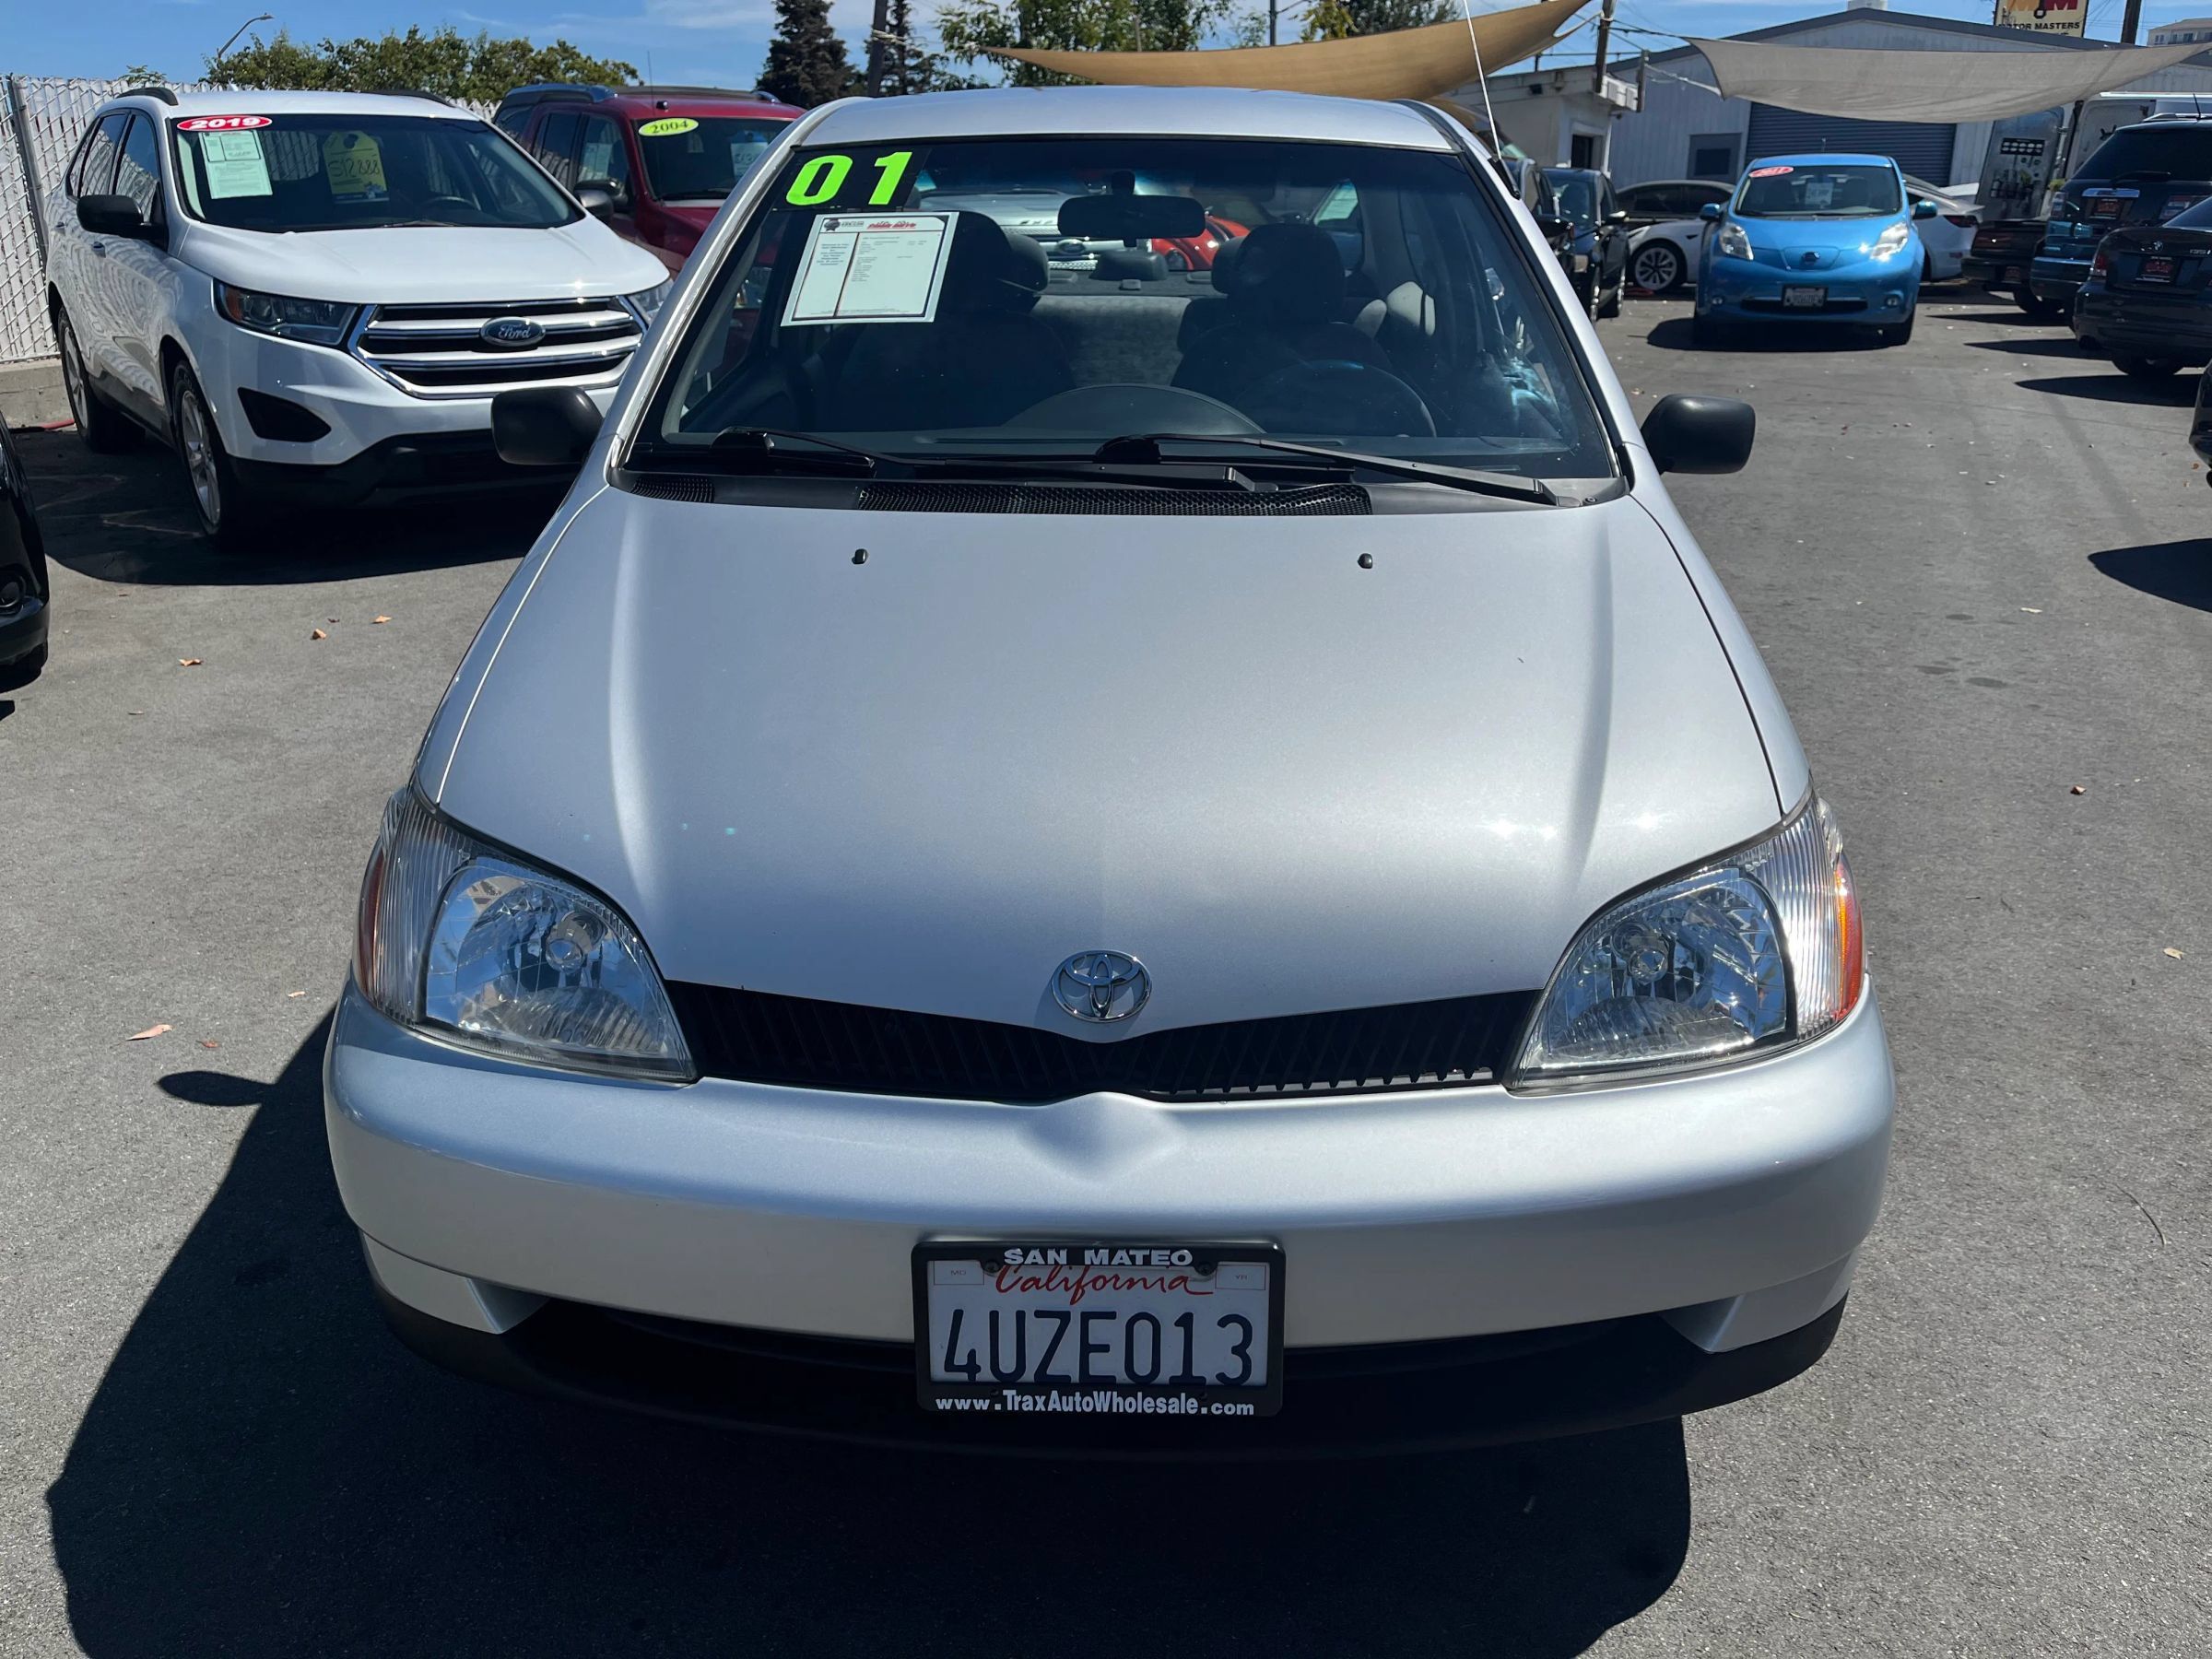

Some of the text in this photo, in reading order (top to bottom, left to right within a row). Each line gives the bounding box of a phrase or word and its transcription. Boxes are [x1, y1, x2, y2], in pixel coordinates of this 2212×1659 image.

[189, 117, 261, 129] 2019
[651, 120, 689, 134] 2004
[498, 324, 532, 339] Ford
[1004, 1248, 1193, 1266] SAN MATEO
[995, 1265, 1214, 1305] California
[944, 1309, 1253, 1384] 4UZE013
